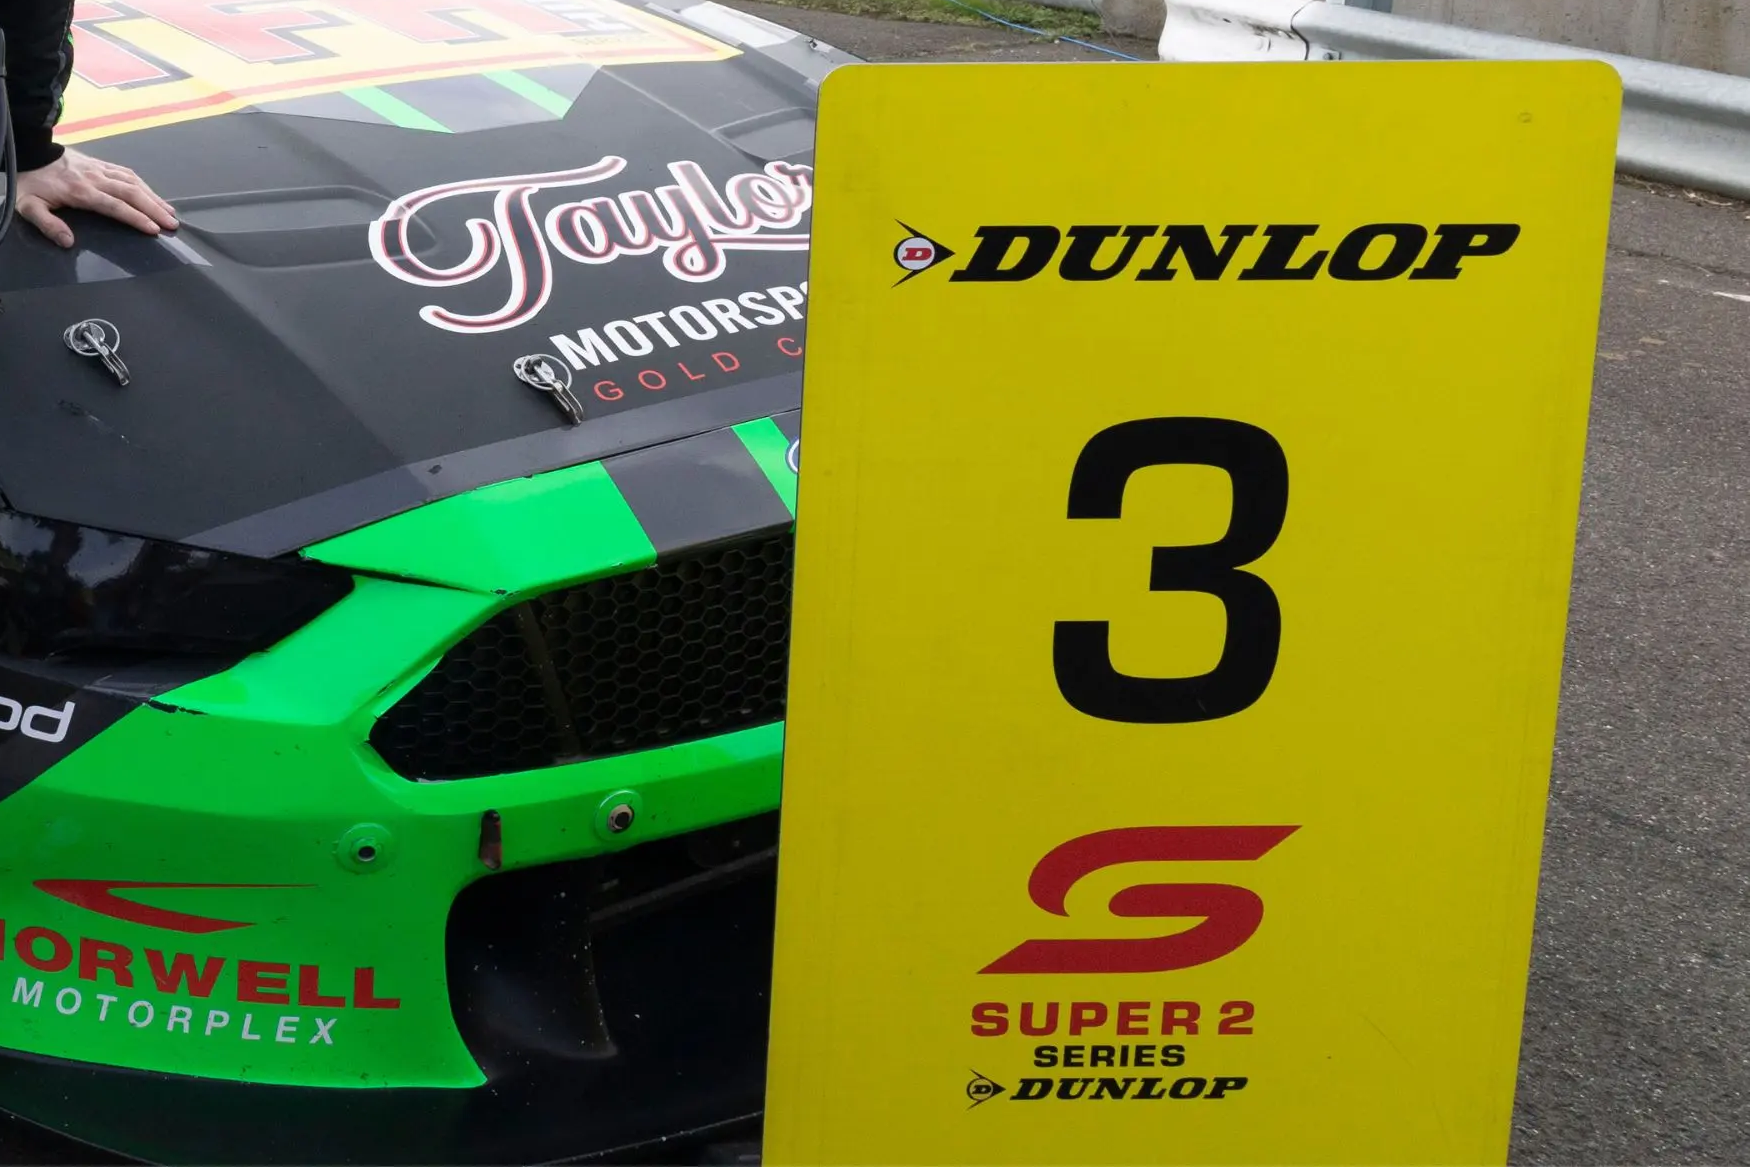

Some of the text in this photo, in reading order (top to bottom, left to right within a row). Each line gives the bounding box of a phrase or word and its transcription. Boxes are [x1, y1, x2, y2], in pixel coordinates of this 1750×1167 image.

[368, 156, 813, 333] Taylor
[949, 222, 1521, 283] DUNLOP
[550, 281, 807, 370] MOTORSP
[593, 351, 741, 401] GOLD
[1053, 416, 1289, 724] 3
[11, 977, 339, 1046] MOTORPLEX
[1009, 1076, 1248, 1101] DUNLOP
[1033, 1044, 1186, 1068] SERIES
